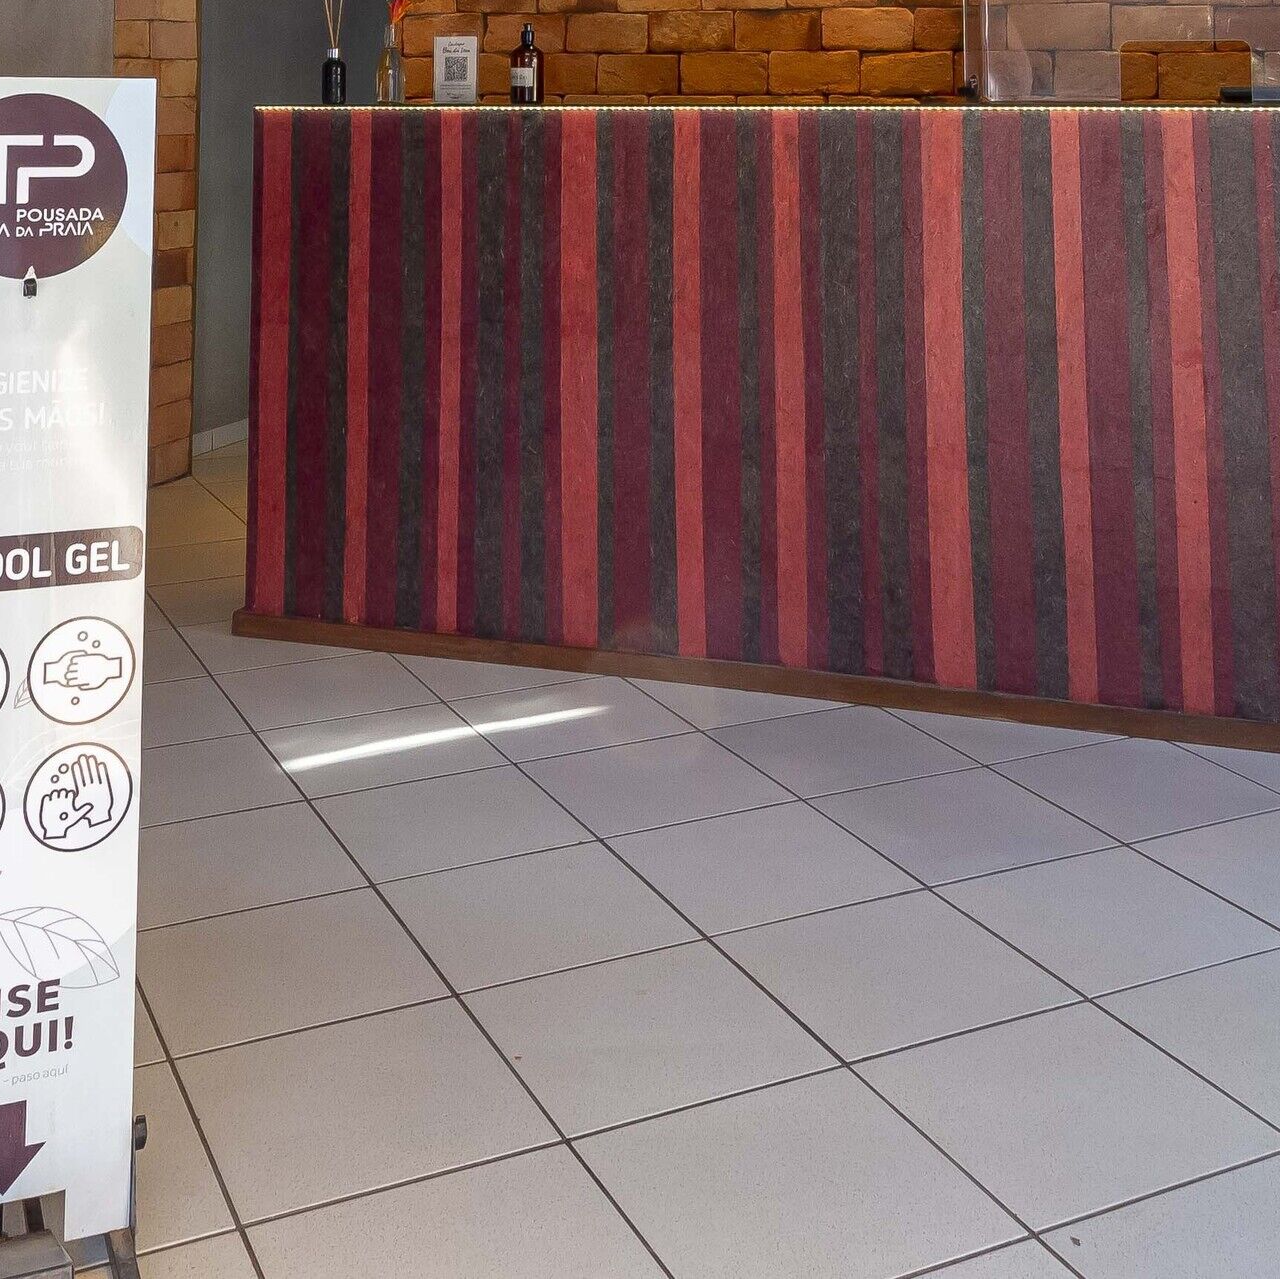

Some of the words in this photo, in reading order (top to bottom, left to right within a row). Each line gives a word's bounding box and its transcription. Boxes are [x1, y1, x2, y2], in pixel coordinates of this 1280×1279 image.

[16, 207, 105, 223] POUSADA
[15, 226, 34, 238] DA
[38, 221, 94, 237] PRAIA
[24, 399, 106, 431] MÃ!
[65, 539, 131, 576] GEL
[11, 1071, 40, 1086] paso
[42, 1064, 69, 1079] aquí
